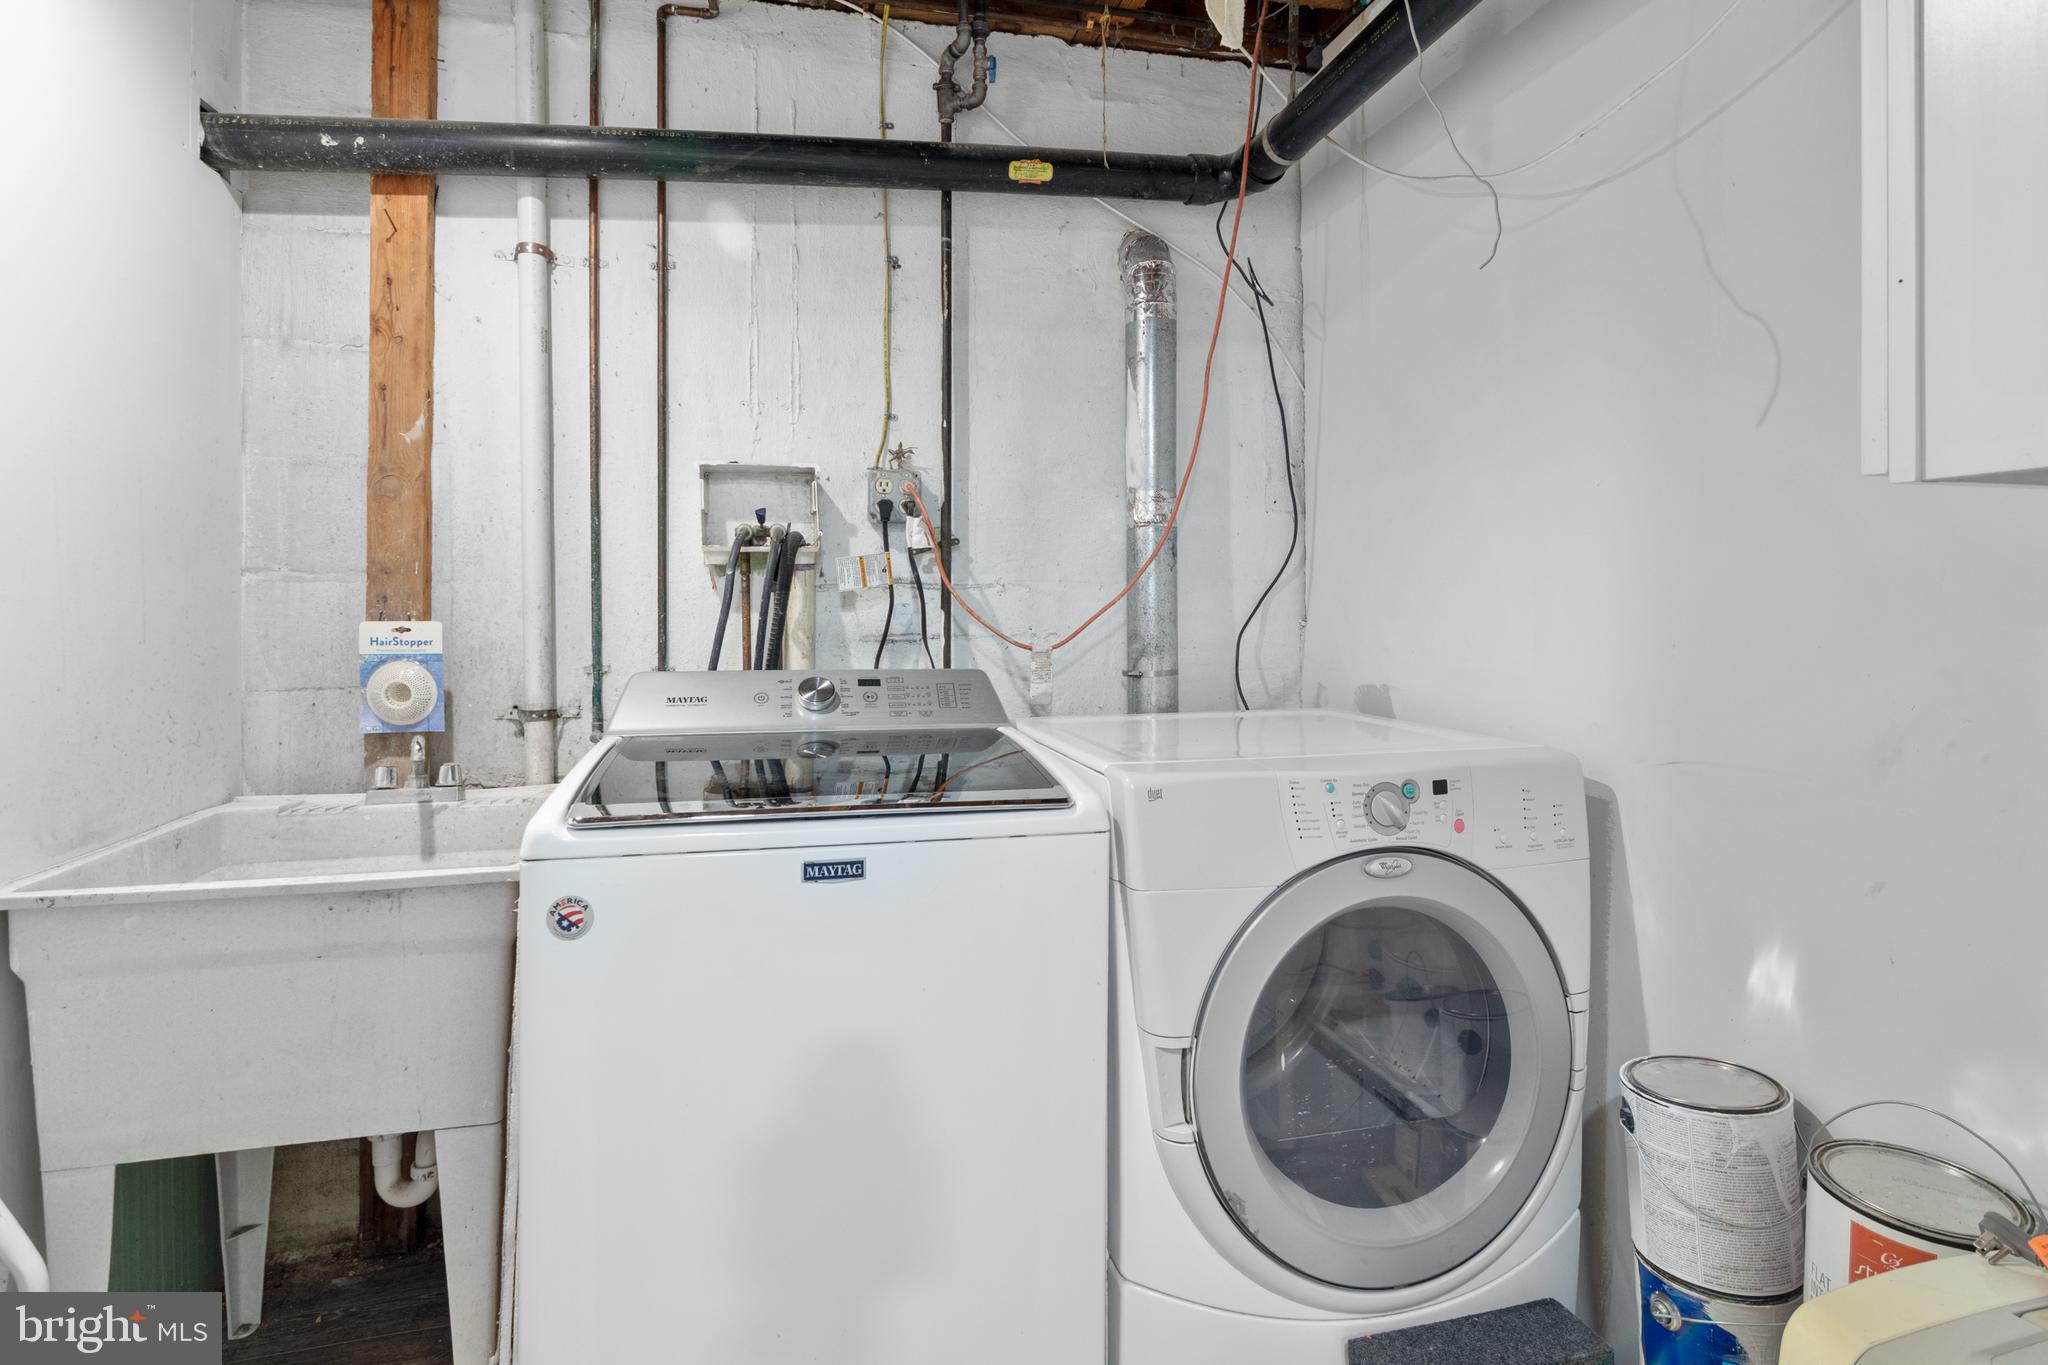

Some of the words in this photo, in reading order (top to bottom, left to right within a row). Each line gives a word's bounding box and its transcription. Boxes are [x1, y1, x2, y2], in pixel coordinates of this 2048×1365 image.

[370, 637, 433, 648] HairStopper
[666, 696, 708, 704] MAYTAG
[806, 863, 862, 878] MAYTAG
[549, 897, 589, 917] AMERICA
[1811, 1261, 1832, 1293] FLAT
